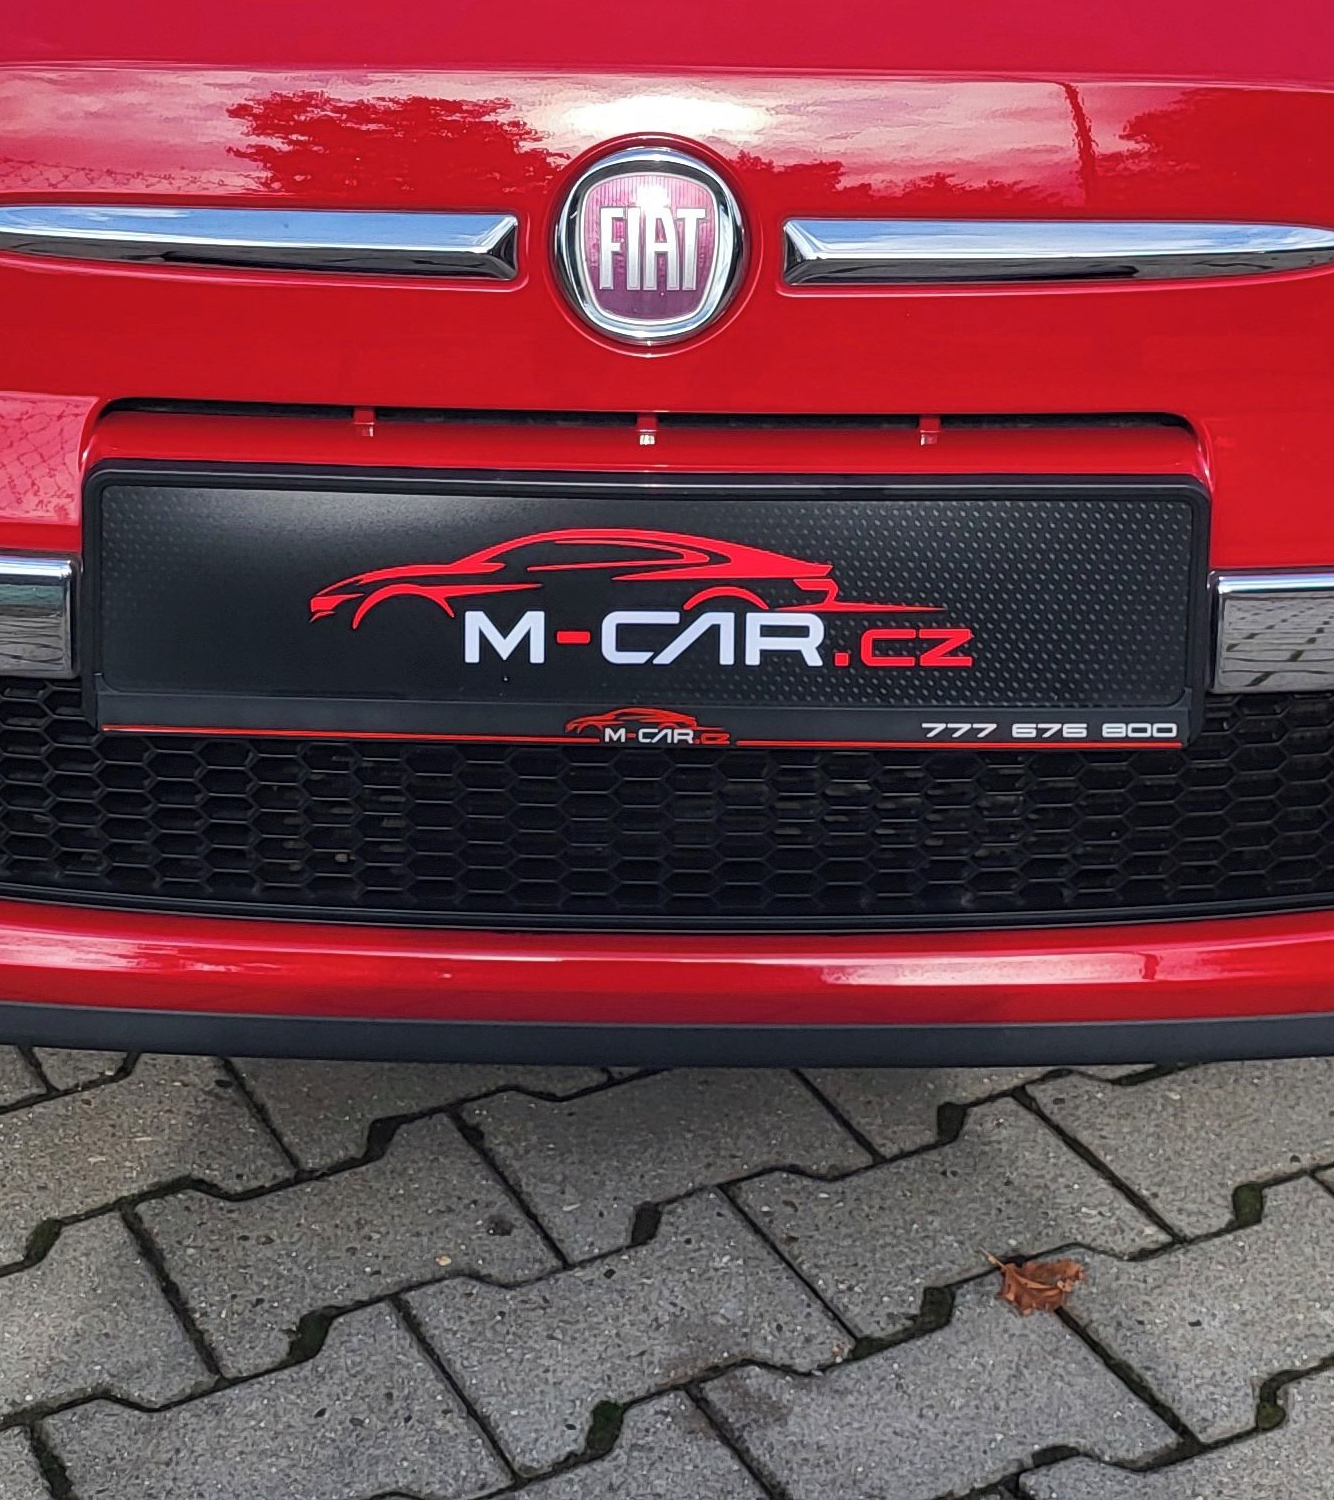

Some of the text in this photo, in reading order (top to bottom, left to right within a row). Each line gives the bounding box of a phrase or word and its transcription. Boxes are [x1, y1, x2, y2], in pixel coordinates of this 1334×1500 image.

[598, 205, 708, 291] FIAT
[921, 722, 1178, 739] 777 676 800
